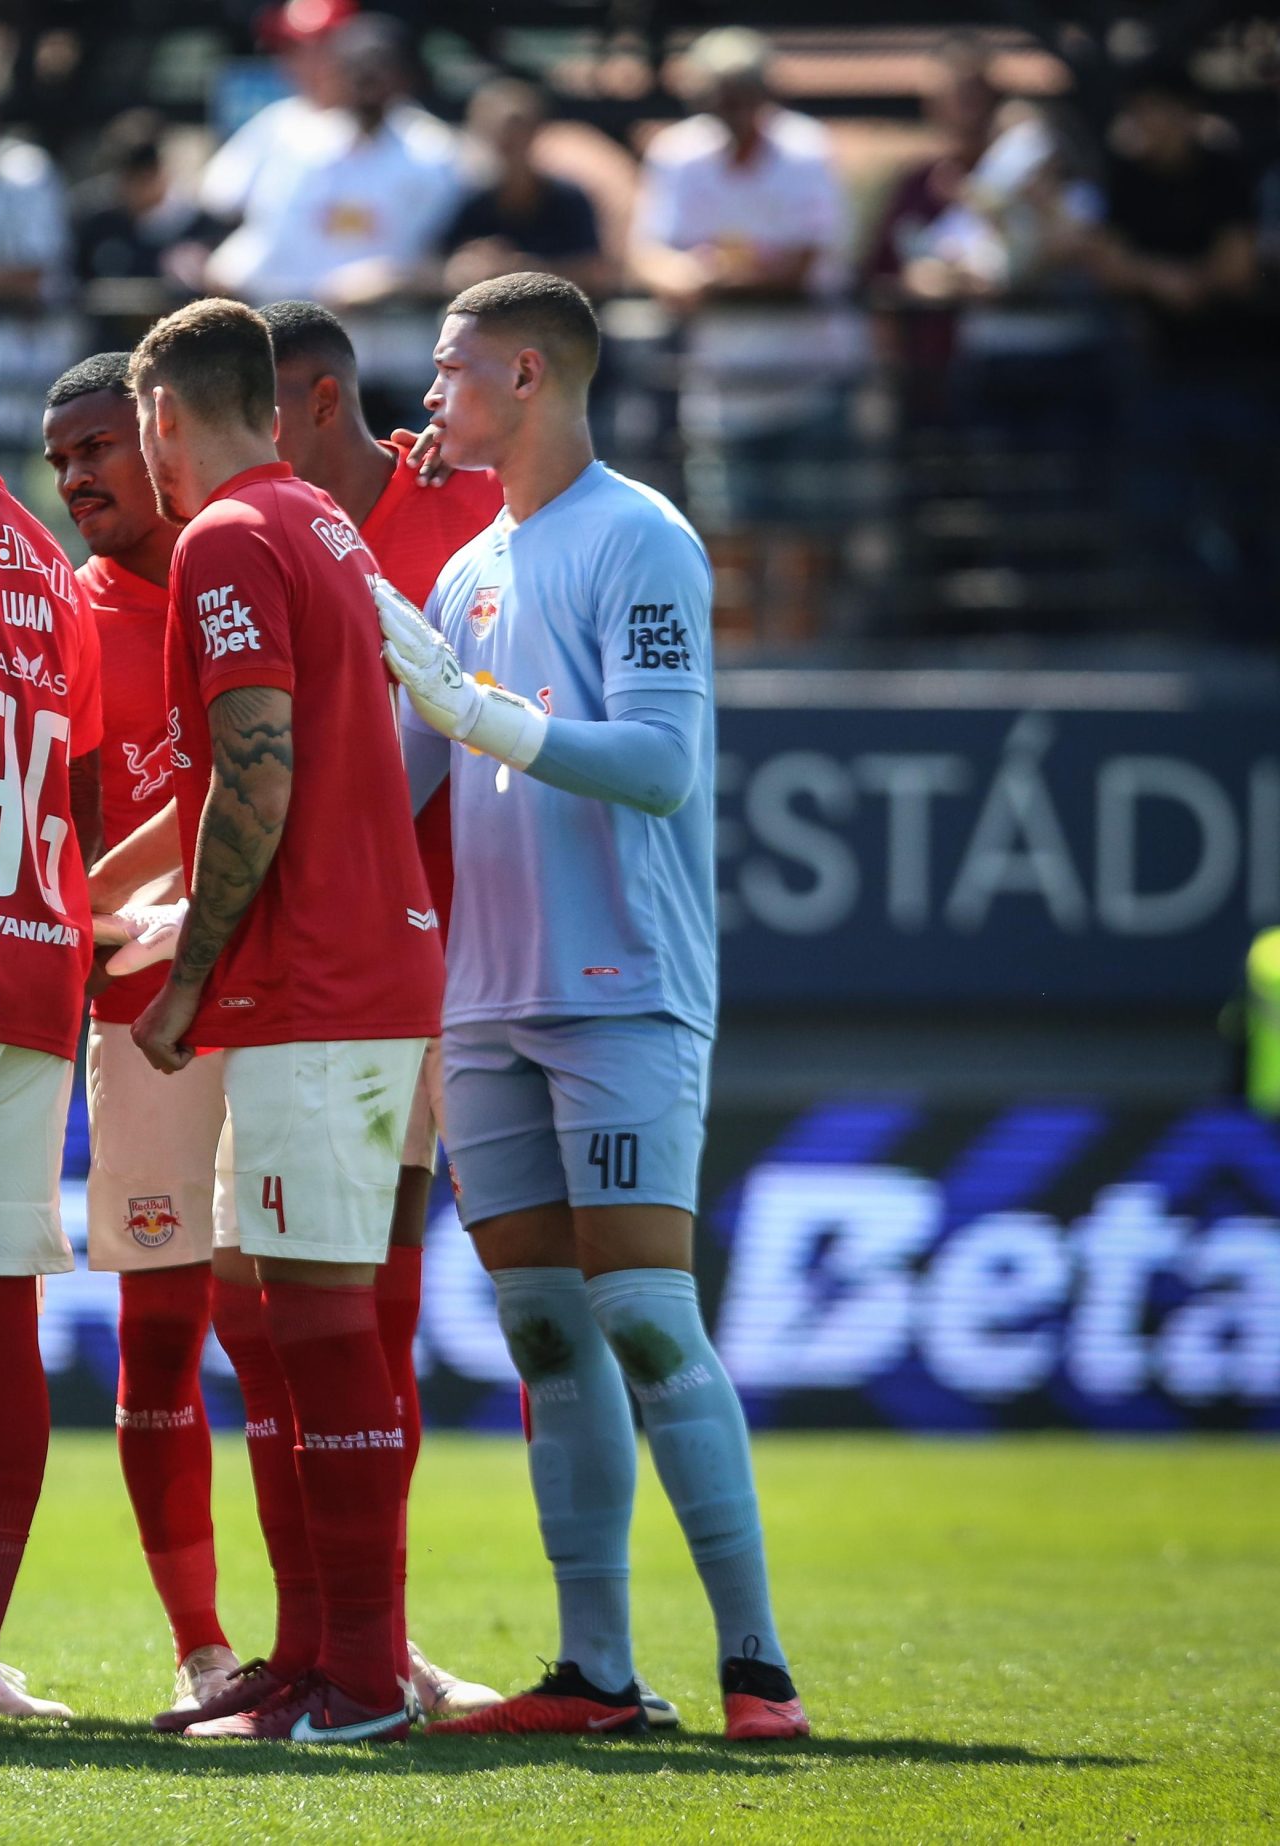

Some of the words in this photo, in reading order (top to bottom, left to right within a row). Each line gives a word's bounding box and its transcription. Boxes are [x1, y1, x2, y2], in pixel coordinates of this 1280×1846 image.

[1, 590, 53, 634] LUAN
[197, 585, 233, 616] mr
[629, 603, 674, 624] mr
[200, 600, 253, 654] jack
[621, 619, 687, 661] jack
[588, 1132, 638, 1189] 40
[262, 1176, 287, 1234] 4
